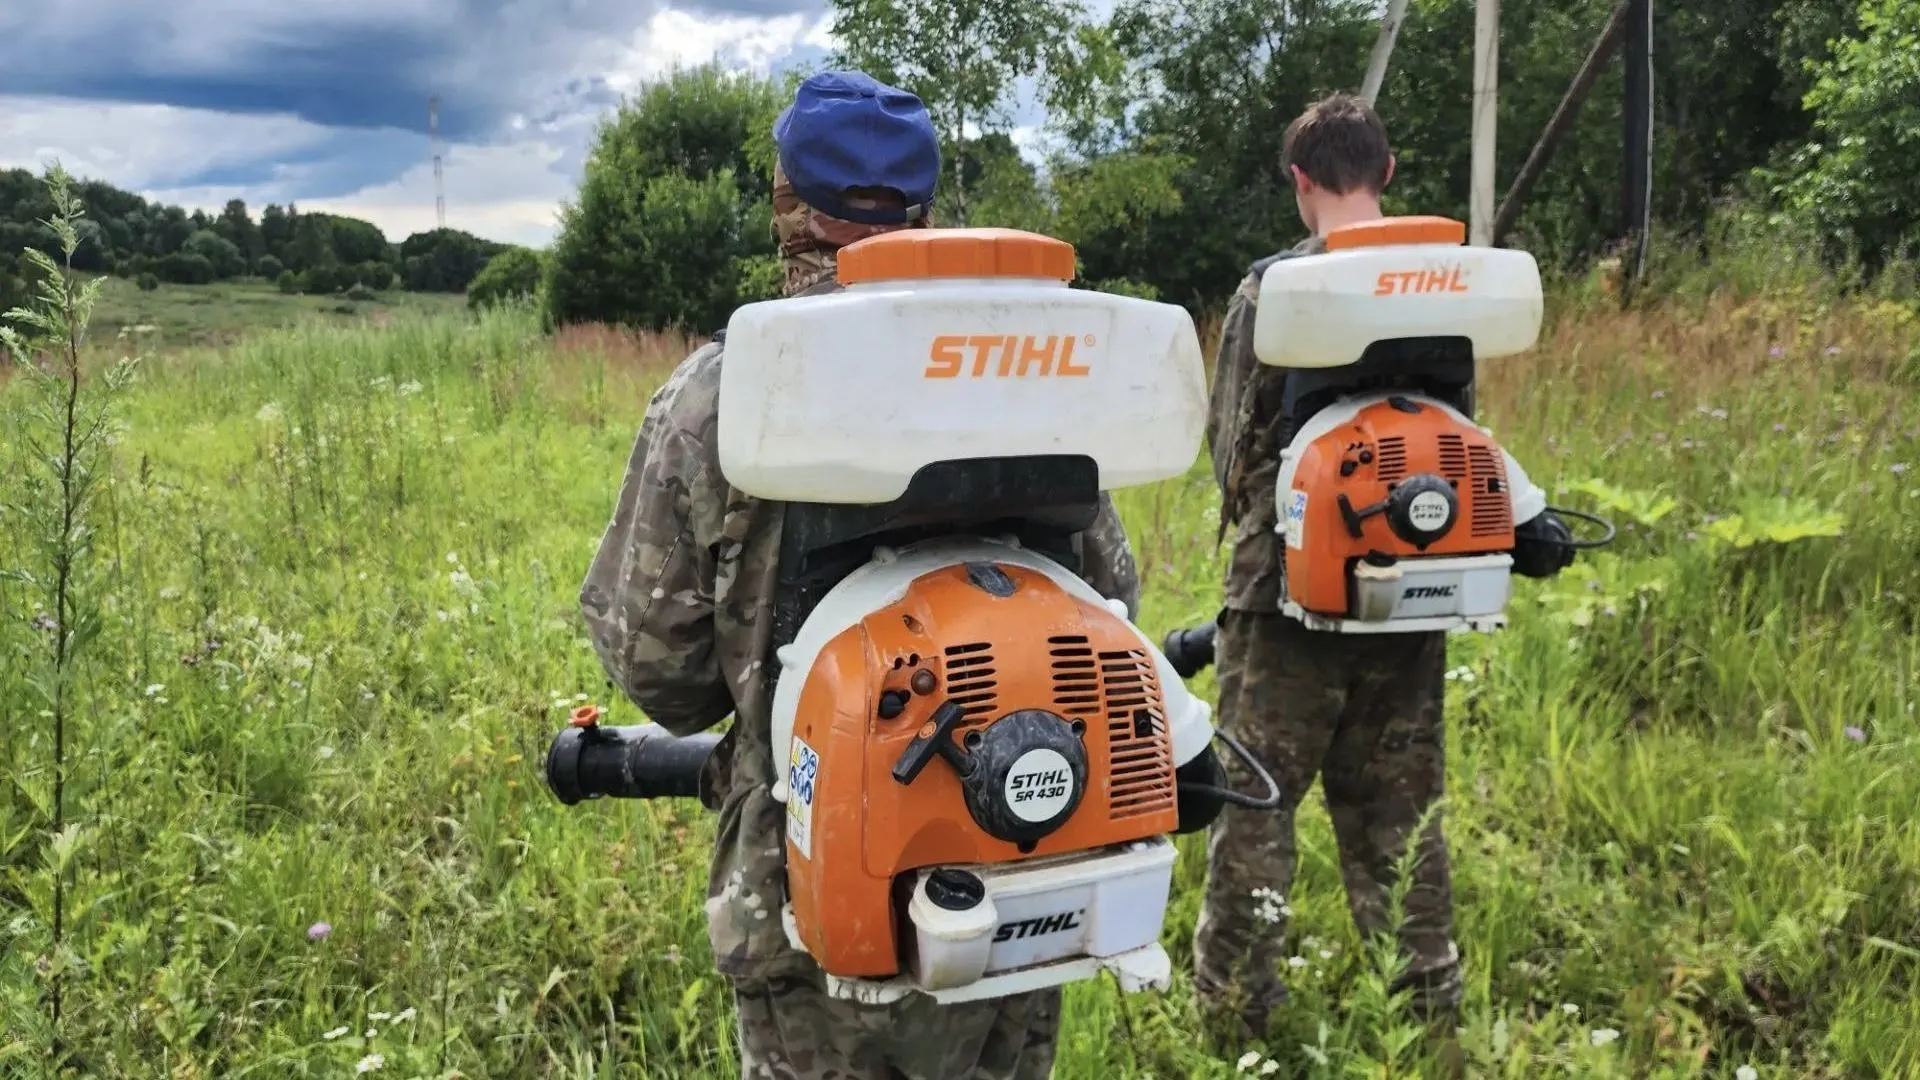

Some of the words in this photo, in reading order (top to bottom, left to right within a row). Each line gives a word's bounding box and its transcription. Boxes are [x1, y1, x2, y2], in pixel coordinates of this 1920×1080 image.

[1374, 267, 1468, 296] STIHL
[924, 335, 1090, 378] STIHL
[1402, 586, 1454, 600] STIHL
[1010, 769, 1068, 790] STIHL
[1014, 791, 1034, 803] SR
[1036, 786, 1066, 799] 430
[992, 911, 1080, 943] STIHL
